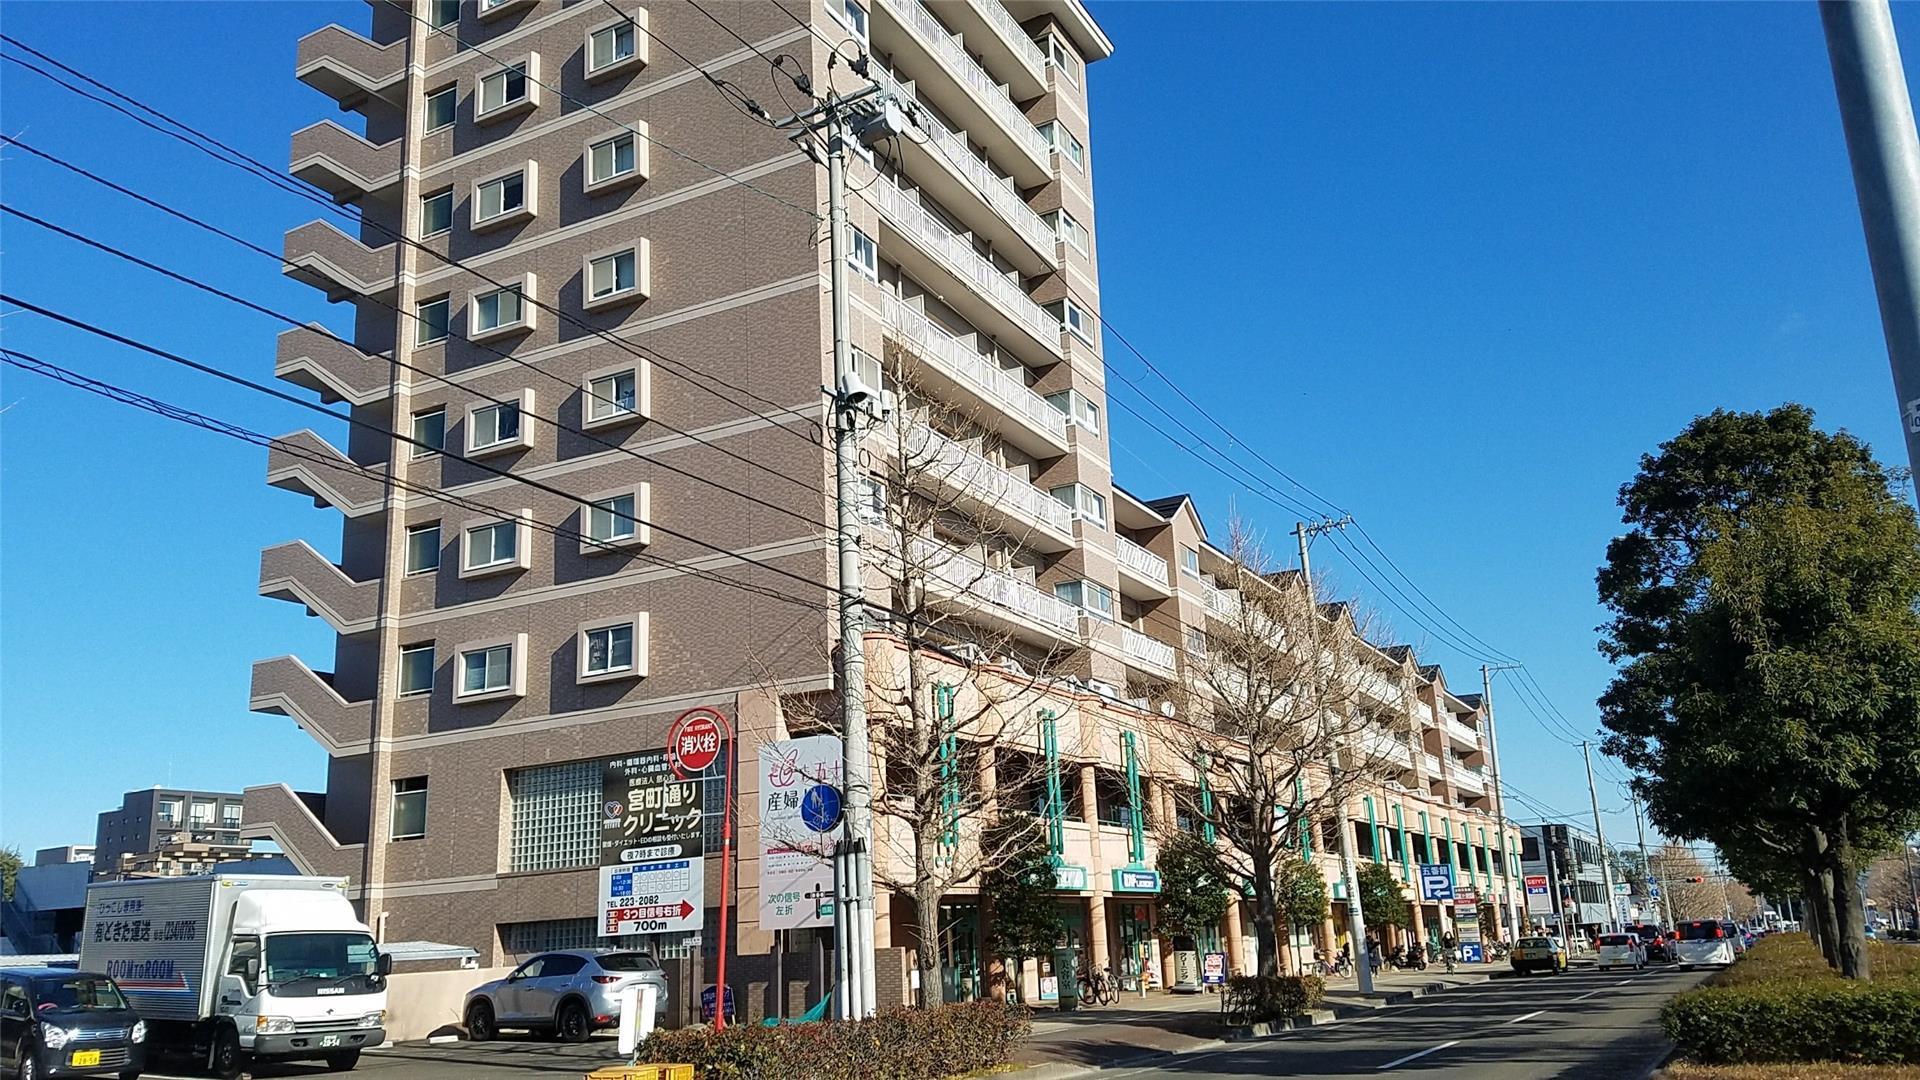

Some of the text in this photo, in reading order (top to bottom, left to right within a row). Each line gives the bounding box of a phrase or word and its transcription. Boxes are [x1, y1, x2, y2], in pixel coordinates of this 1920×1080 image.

[680, 732, 717, 756] 消火栓
[628, 782, 696, 811] 宮町通り
[623, 807, 702, 837] クリニック
[627, 846, 676, 860] 夜7時まで診療
[1424, 876, 1449, 898] P
[607, 901, 617, 909] TEL
[767, 891, 801, 905] 次の信号
[623, 905, 682, 921] 3つ目信号右折
[775, 904, 793, 916] 左折
[633, 919, 667, 932] 700m
[317, 987, 345, 995] NISSAN
